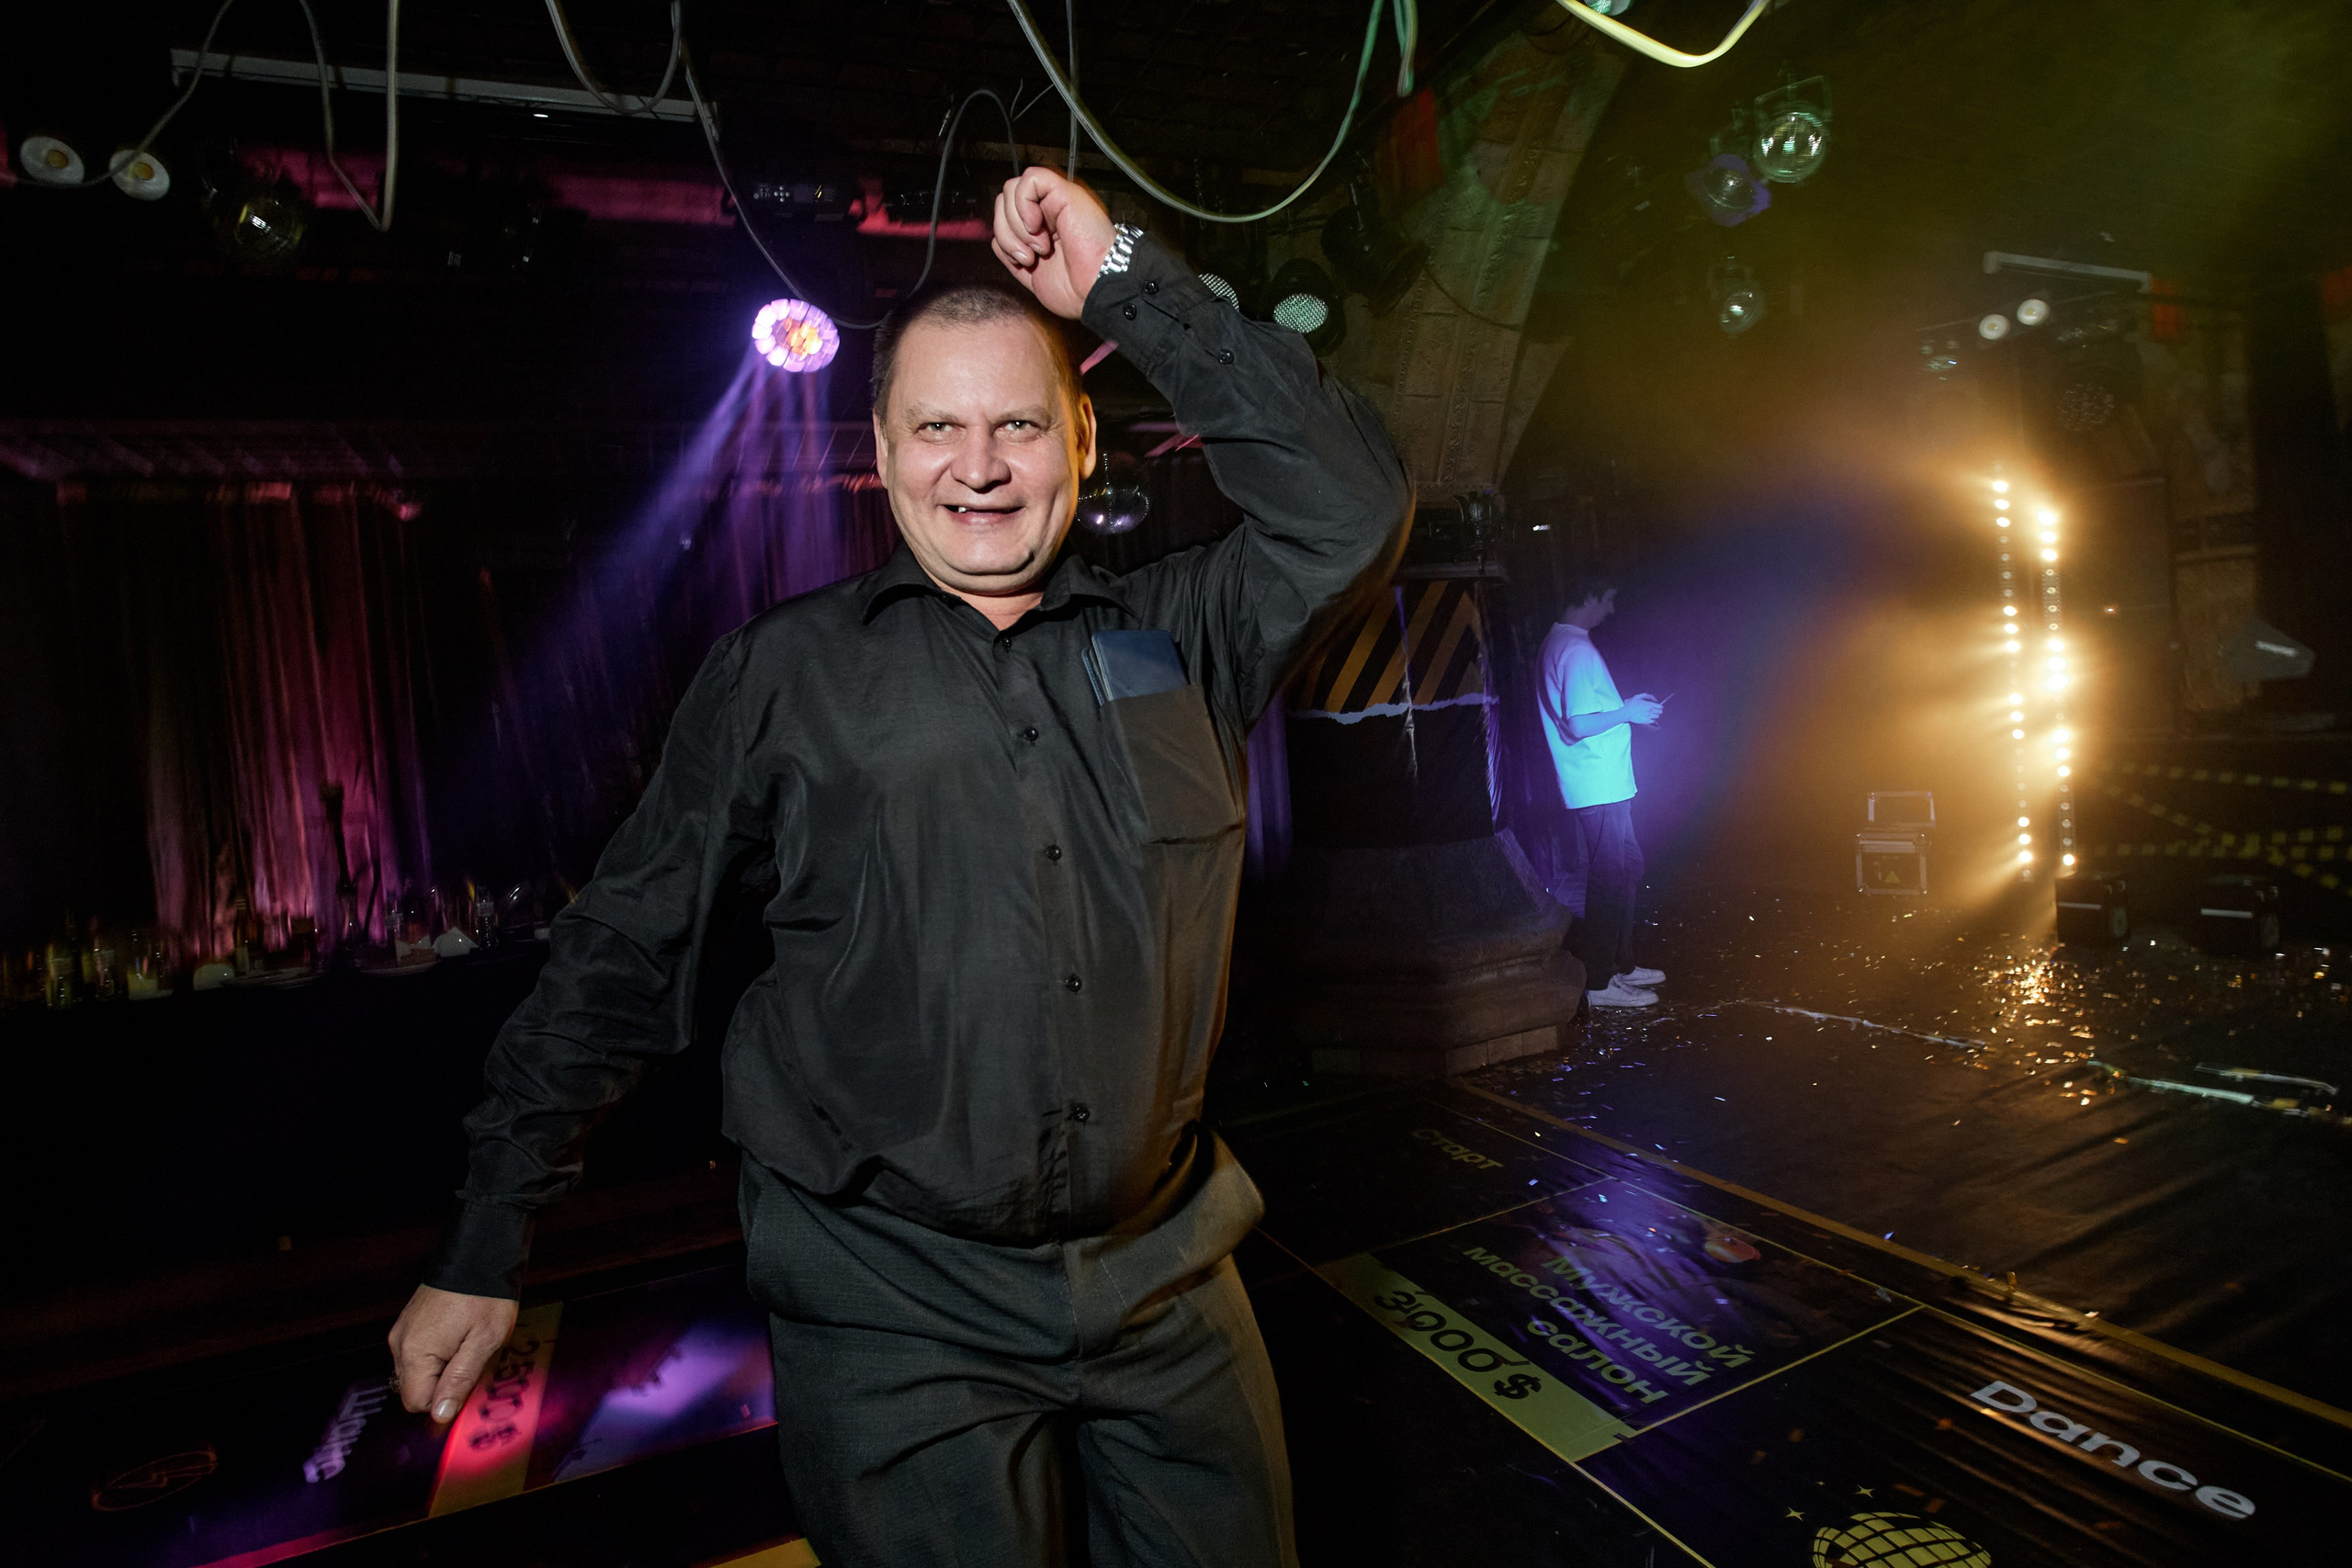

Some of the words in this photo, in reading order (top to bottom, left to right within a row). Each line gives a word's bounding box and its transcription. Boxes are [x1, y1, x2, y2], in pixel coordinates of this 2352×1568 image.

[1412, 1128, 1504, 1169] Старт
[1462, 1247, 1715, 1386] массажный
[1526, 1319, 1669, 1404] салон
[1541, 1254, 1756, 1369] Мужской
[1970, 1379, 2256, 1521] Dance
